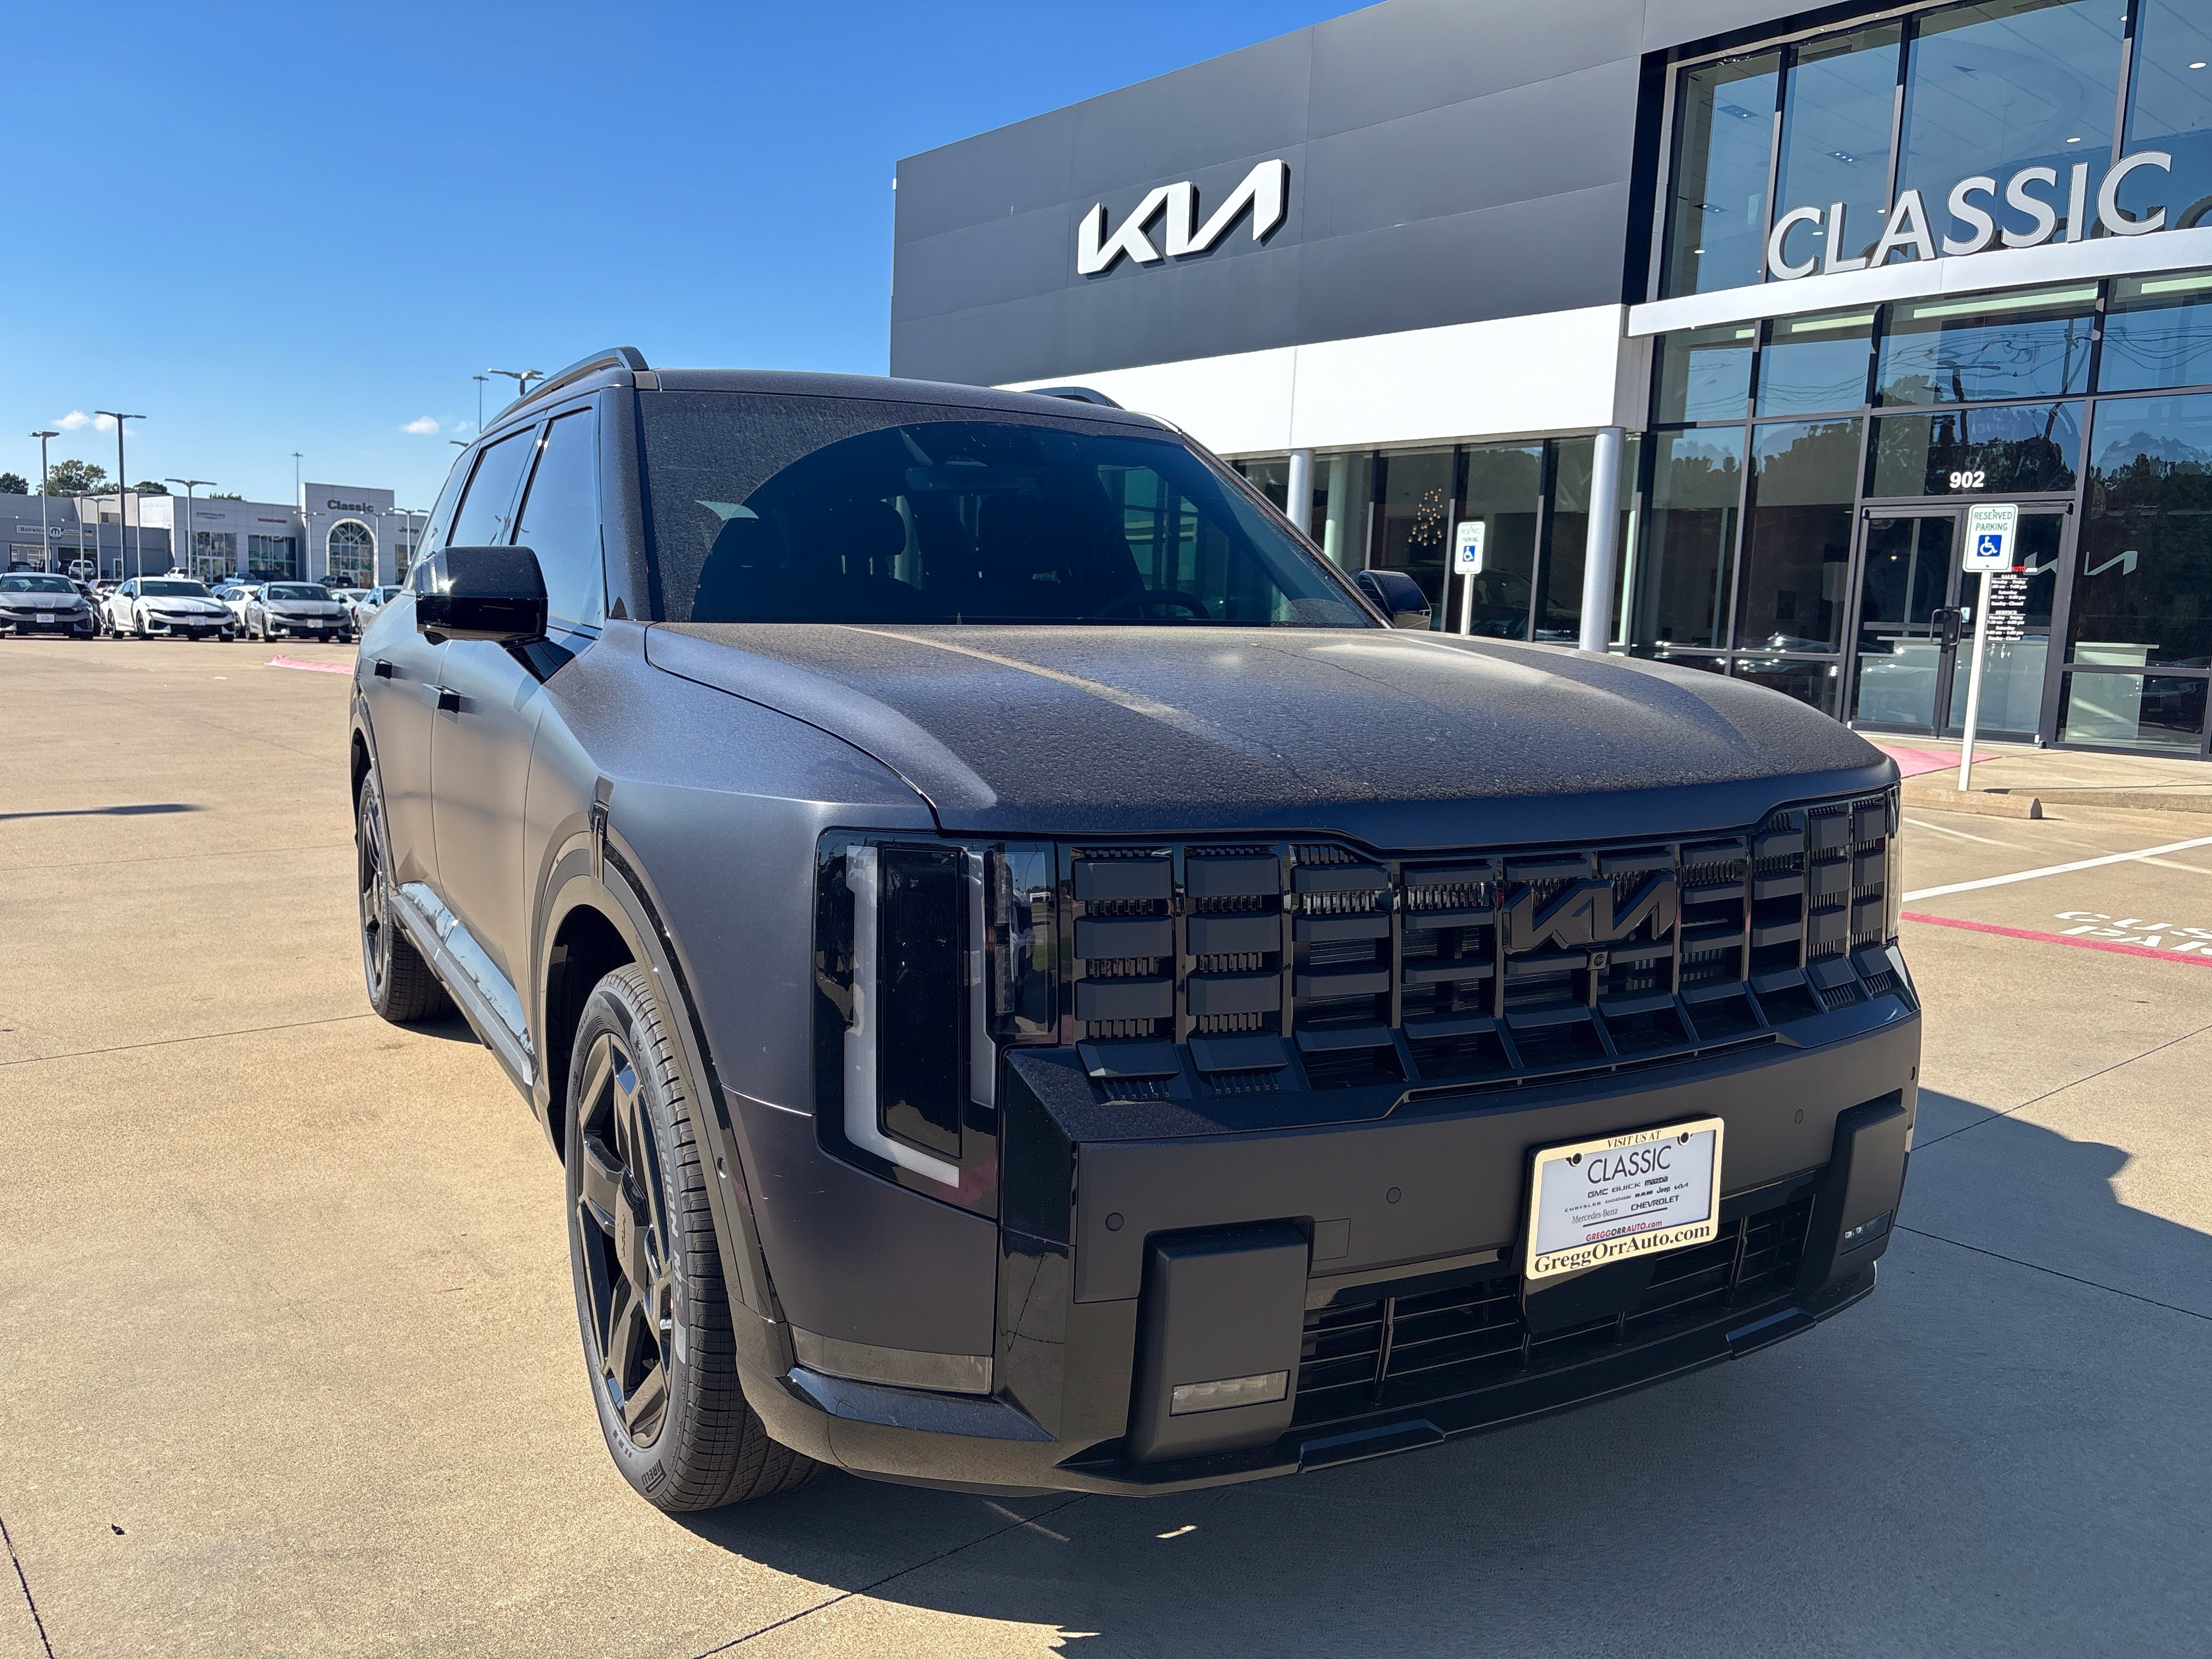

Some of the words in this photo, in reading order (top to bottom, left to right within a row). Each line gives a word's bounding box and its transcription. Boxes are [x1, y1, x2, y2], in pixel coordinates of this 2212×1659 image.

[1077, 159, 1284, 275] KIA
[1767, 150, 2172, 280] CLASSIC
[1949, 471, 1985, 488] 902
[327, 500, 374, 512] Classic
[1973, 511, 2013, 520] RESERVED
[1975, 523, 2008, 531] PARKING
[1503, 874, 1677, 953] KIA
[1607, 1136, 1633, 1148] VISIT
[1635, 1133, 1647, 1143] US
[1648, 1130, 1662, 1141] AT
[1587, 1145, 1672, 1184] CLASSIC
[1564, 1201, 1602, 1212] CHRYSLER
[1605, 1195, 1632, 1204] DODGE
[1635, 1190, 1653, 1198] RAM
[1656, 1186, 1671, 1194] Jeep
[1674, 1182, 1689, 1190] KIA
[1588, 1188, 1609, 1198] GMC
[1611, 1182, 1641, 1193] BUICK
[1644, 1176, 1668, 1187] mazda
[1571, 1208, 1618, 1224] Mercedes-Benz
[1630, 1195, 1680, 1211] CHEVROLET
[1585, 1221, 1662, 1242] GREGGORRAUTO.com
[1534, 1225, 1711, 1273] GreggOrrAuto.com
